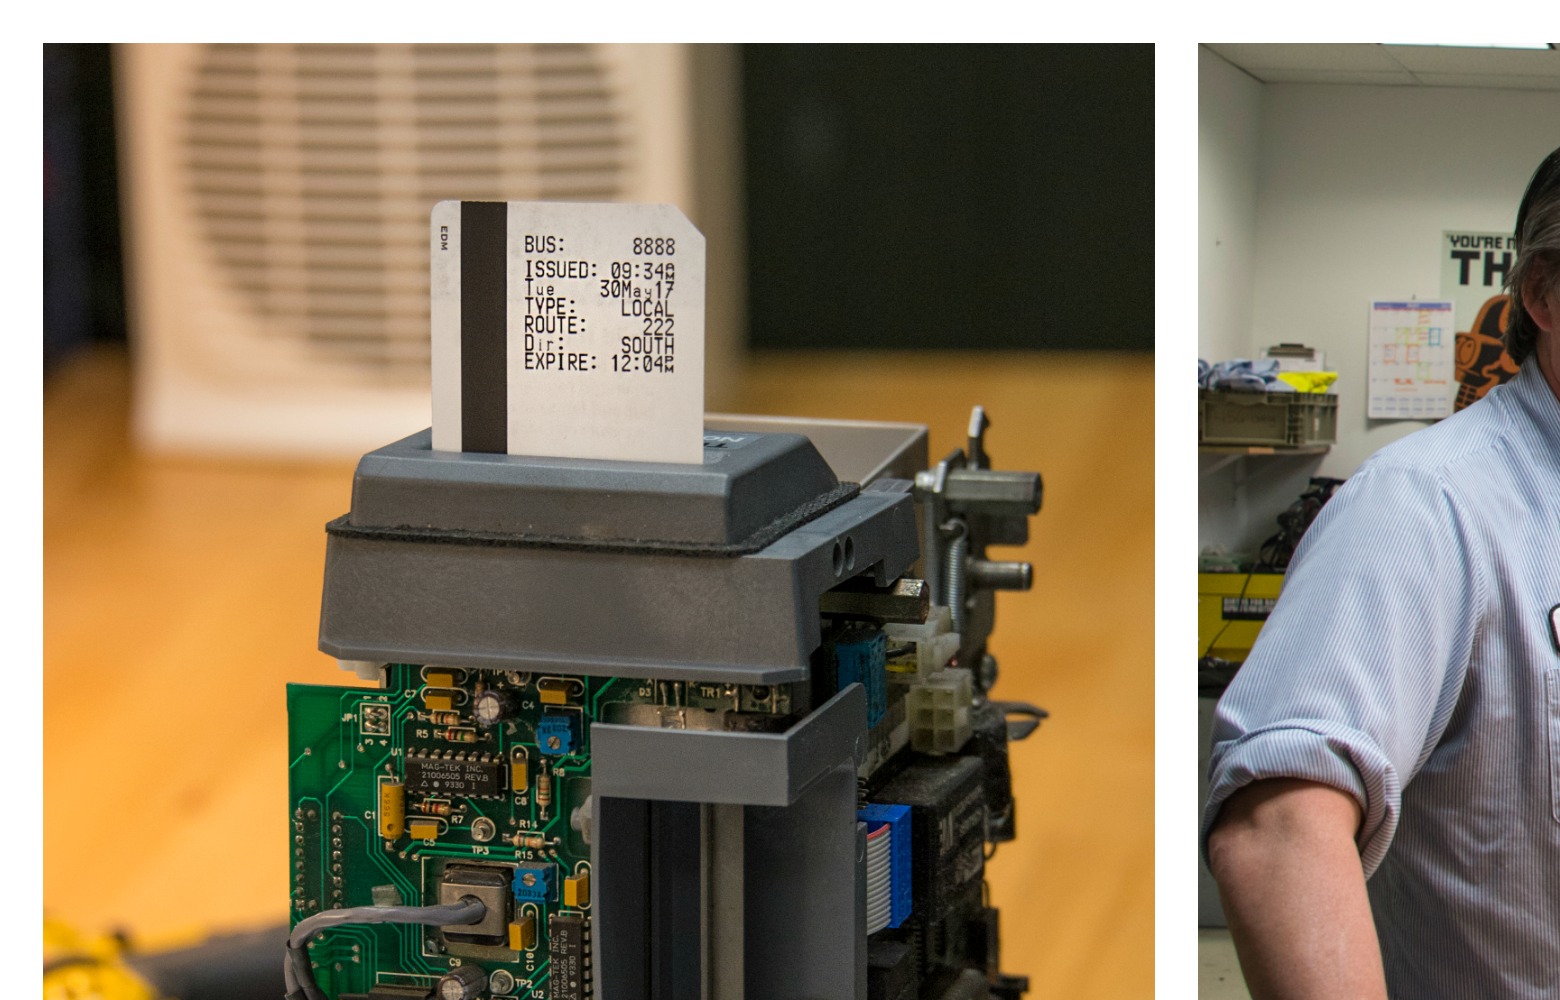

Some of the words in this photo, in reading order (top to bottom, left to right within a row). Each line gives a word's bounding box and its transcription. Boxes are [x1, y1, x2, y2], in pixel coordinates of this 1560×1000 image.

[440, 225, 449, 251] EDM
[1450, 234, 1503, 250] YOU'RE
[525, 235, 564, 253] BUS:
[633, 237, 675, 256] 8888
[526, 260, 597, 279] ISSUED:
[524, 278, 555, 296] Tue
[600, 279, 675, 299] 30May17
[525, 296, 575, 315] TYPE:
[622, 298, 674, 317] LOCAL
[525, 315, 585, 334] ROUTE:
[643, 317, 674, 337] 222
[525, 333, 564, 352] Dir:
[622, 336, 674, 355] SOUTH
[525, 351, 597, 371] EXPIRE:
[404, 689, 417, 698] C7
[638, 687, 652, 697] D3
[700, 687, 720, 699] TR1
[522, 700, 535, 710] C4
[342, 713, 358, 723] JP1
[416, 729, 428, 739] R5
[391, 748, 402, 757] U1
[421, 762, 461, 772] MAG-TEK
[466, 764, 484, 773] INC.
[421, 771, 461, 781] 21006505
[444, 781, 465, 789] 9330
[364, 810, 376, 820] C1
[451, 815, 464, 824] R7
[519, 819, 538, 829] R14
[471, 845, 490, 855] TP3
[514, 850, 533, 860] R15
[552, 935, 560, 953] INC.
[449, 957, 462, 967] C9
[569, 955, 577, 976] 9330
[515, 978, 533, 989] TP2
[552, 958, 560, 999] MAG-TEK
[560, 958, 568, 999] 21006505
[531, 990, 545, 999] U2
